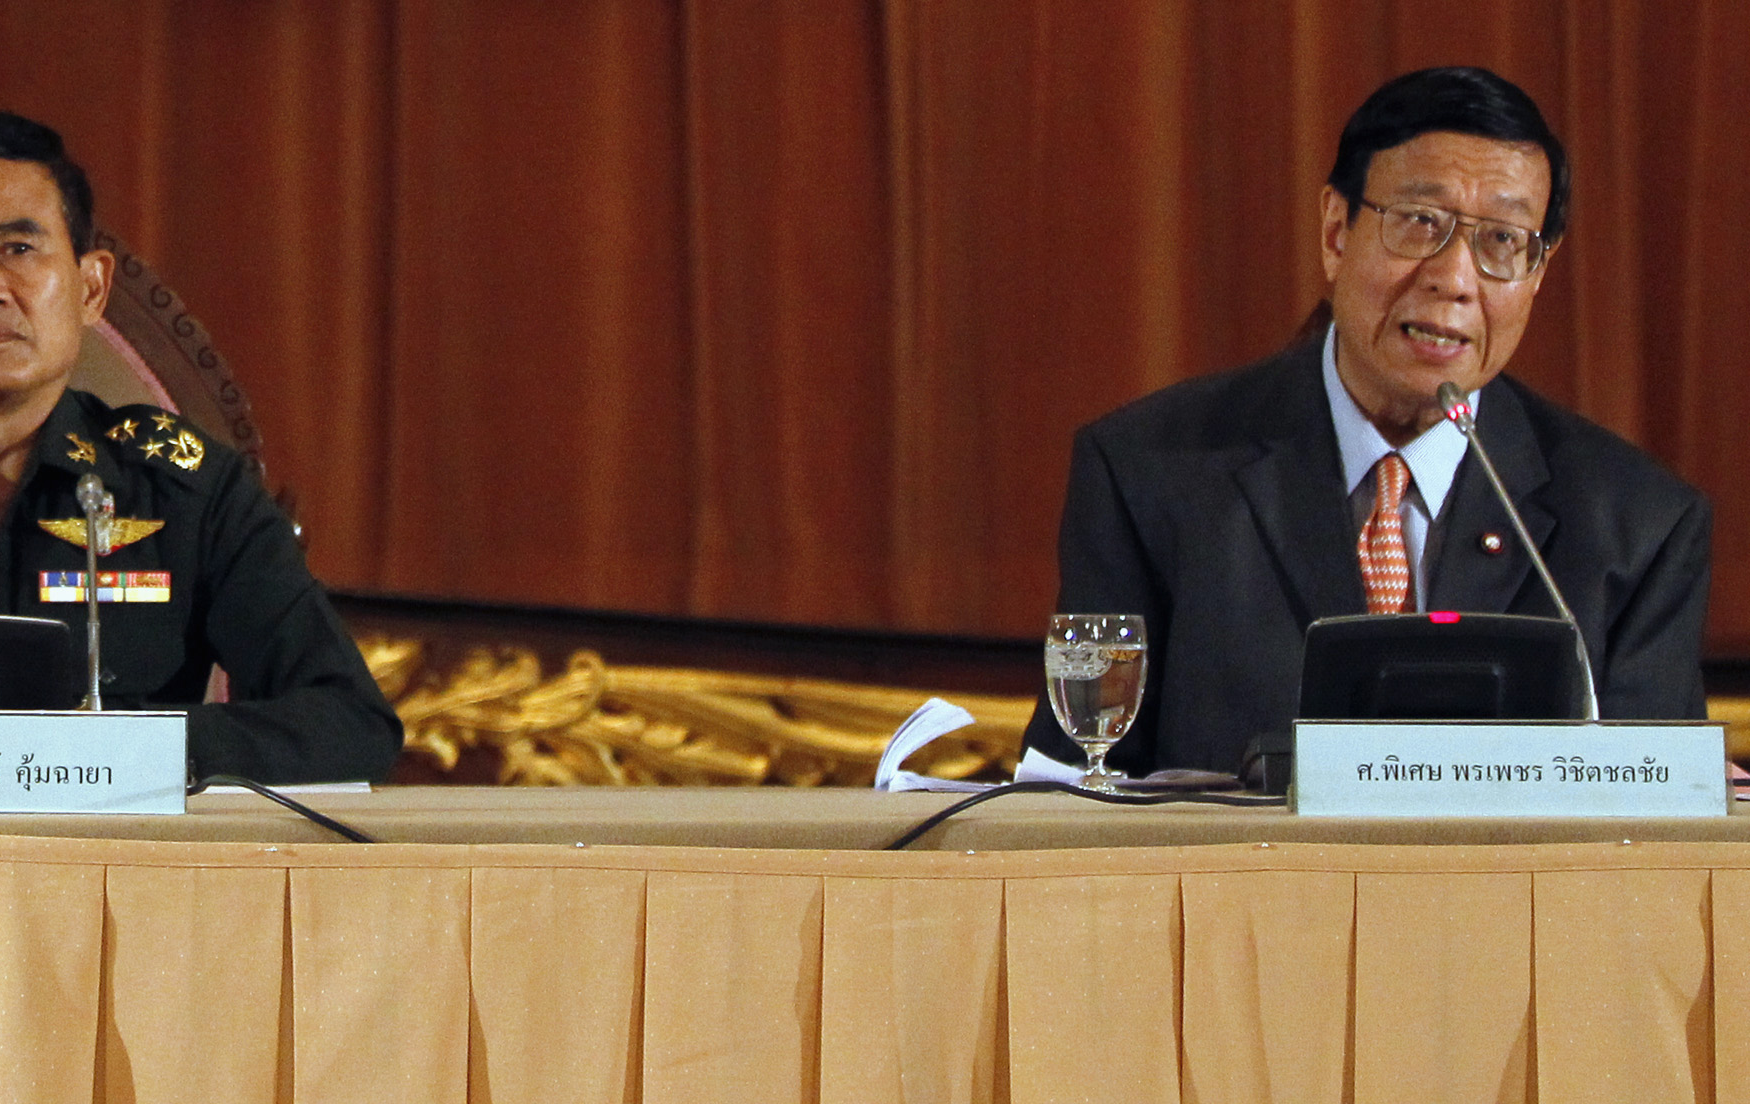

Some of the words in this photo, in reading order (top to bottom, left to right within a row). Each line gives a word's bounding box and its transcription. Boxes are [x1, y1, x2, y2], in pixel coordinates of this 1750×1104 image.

[15, 753, 113, 793] คุ้มฉายา
[1356, 754, 1443, 783] ศ.พิเศษ
[1451, 763, 1544, 783] พรเพชร
[1552, 754, 1670, 784] วิชิตชลชัย
